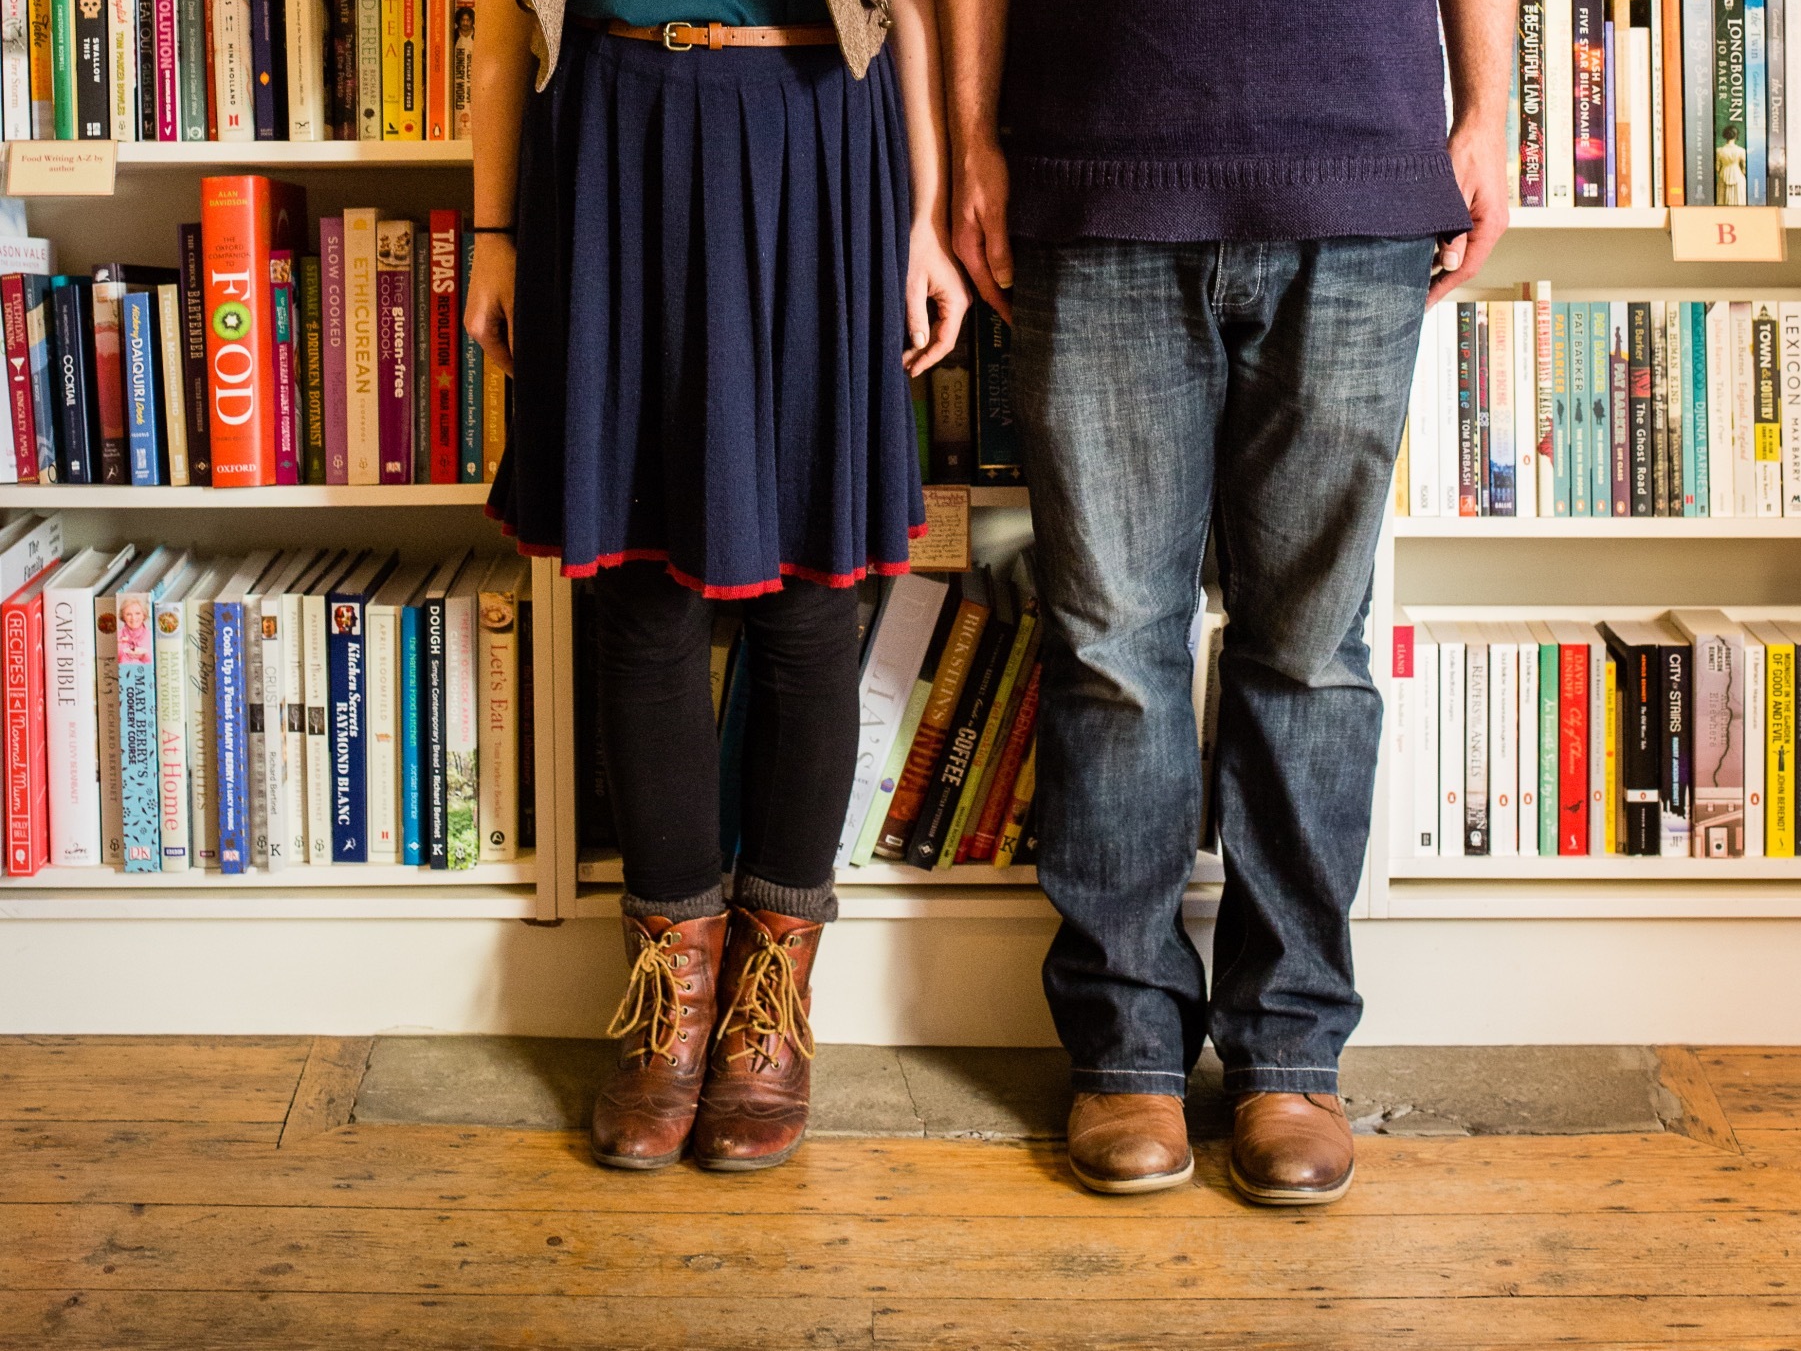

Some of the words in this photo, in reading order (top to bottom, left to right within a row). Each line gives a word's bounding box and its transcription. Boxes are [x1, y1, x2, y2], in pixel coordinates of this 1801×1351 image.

[1580, 8, 1588, 34] FIVE
[83, 37, 91, 60] THIS
[1580, 38, 1589, 68] STAR
[1717, 40, 1726, 54] JO
[1718, 61, 1728, 100] BAKER
[1728, 18, 1742, 122] LONGBOURN
[1580, 73, 1590, 147] BILLIONAIRE
[44, 155, 74, 163] Writing
[94, 155, 104, 163] by
[1715, 223, 1736, 244] B
[328, 236, 340, 278] SLOW
[433, 228, 454, 293] TAPAS
[187, 291, 203, 359] BARTENDER
[330, 285, 341, 347] COOKED
[354, 256, 370, 394] ETHICUREAN
[1575, 313, 1583, 336] PAT
[132, 338, 147, 401] DAIQUIRI
[1575, 340, 1583, 390] BARKER
[1786, 314, 1800, 405] LEXICON
[63, 355, 76, 406] COCKTAIL
[1462, 419, 1470, 439] TOM
[1636, 403, 1646, 424] The
[1462, 441, 1471, 485] BARBASH
[1637, 429, 1646, 461] Ghost
[218, 464, 256, 473] OXFORD
[1638, 466, 1647, 495] Road
[54, 602, 75, 651] CAKE
[430, 606, 440, 654] DOUGH
[10, 618, 25, 685] RECIPES
[490, 644, 507, 690] Let's
[1669, 654, 1681, 682] CITY
[1773, 653, 1782, 666] OF
[57, 657, 76, 706] BIBLE
[134, 675, 148, 715] MARY
[1773, 669, 1782, 696] GOOD
[126, 686, 134, 728] COOKERY
[491, 699, 507, 731] Eat
[1670, 691, 1681, 732] STAIRS
[1773, 700, 1782, 720] AND
[127, 731, 136, 765] COURSE
[136, 720, 149, 778] BERRY'S
[161, 729, 181, 757] At
[337, 702, 348, 774] RAYMOND
[1773, 723, 1782, 743] EVIL
[163, 762, 183, 830] Home
[338, 777, 350, 825] BLANC
[1777, 773, 1785, 792] JOHN
[1777, 793, 1785, 832] BERENDT
